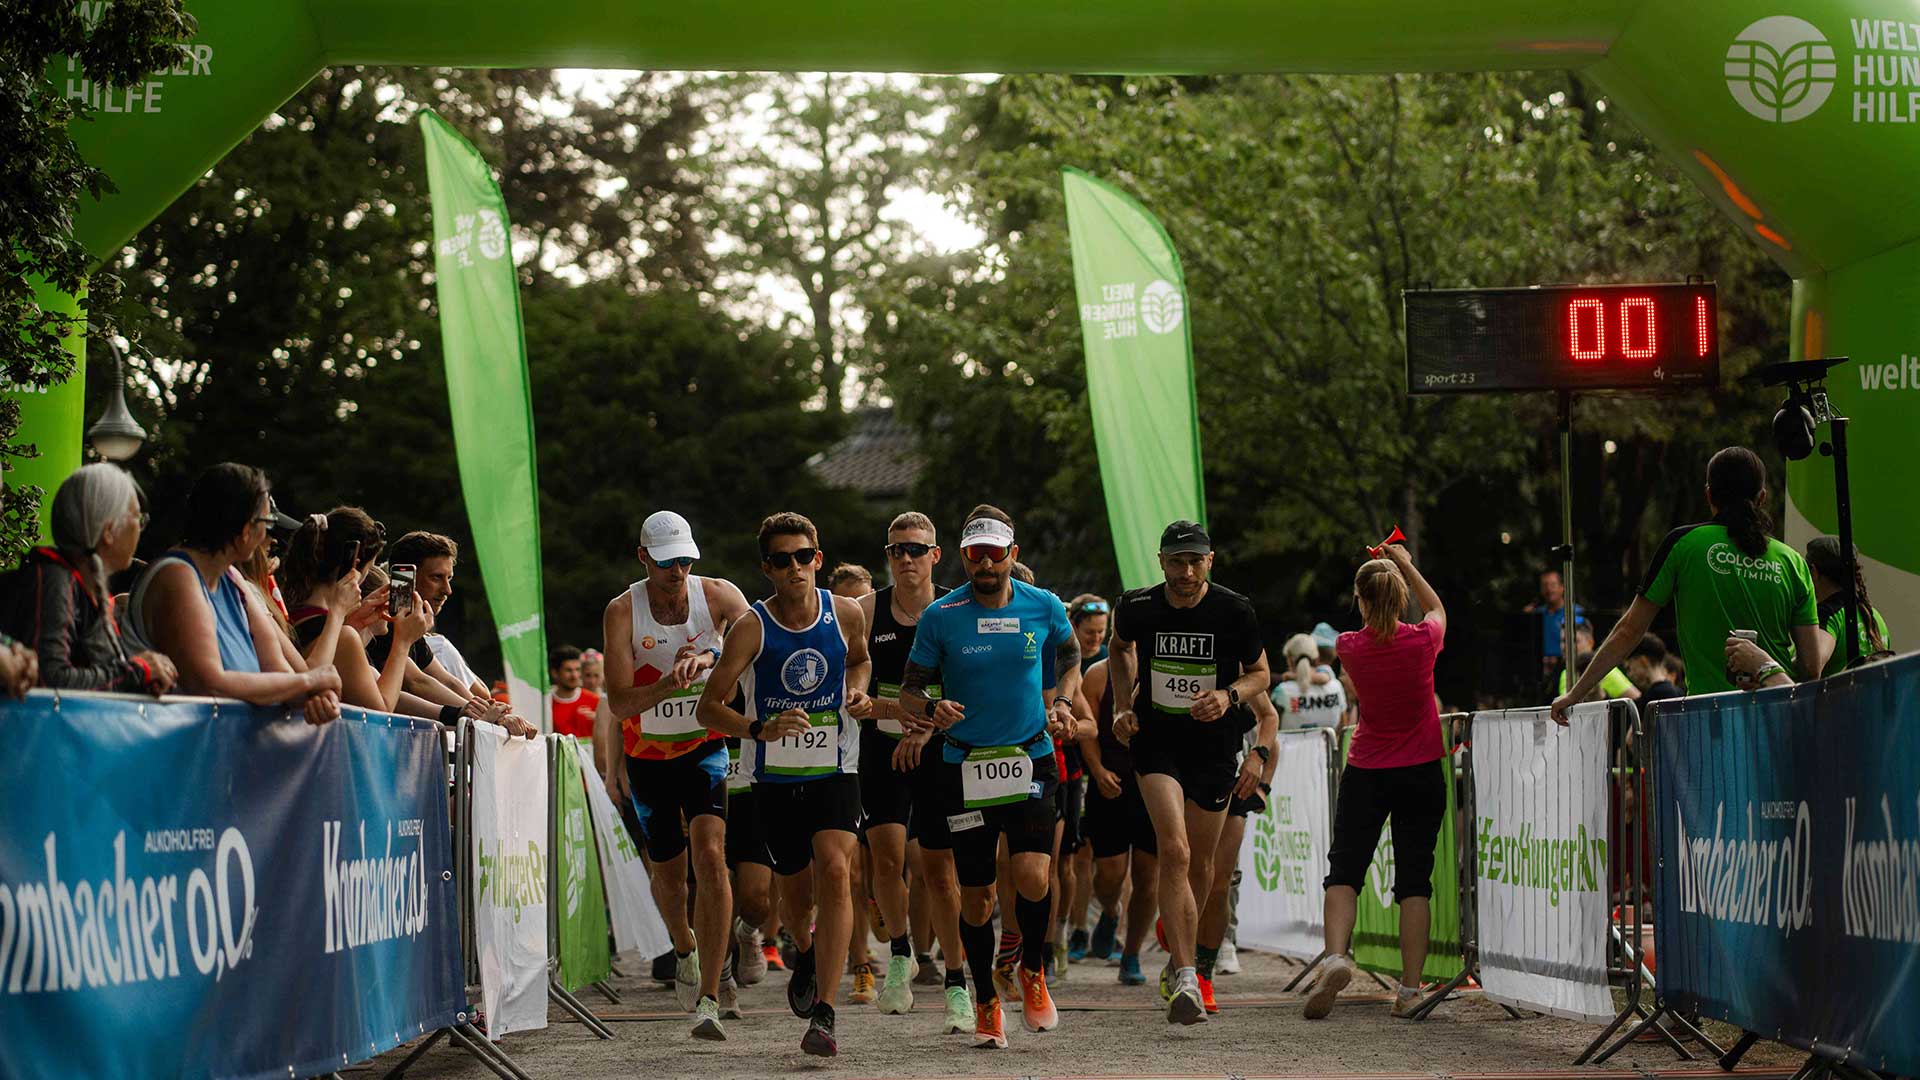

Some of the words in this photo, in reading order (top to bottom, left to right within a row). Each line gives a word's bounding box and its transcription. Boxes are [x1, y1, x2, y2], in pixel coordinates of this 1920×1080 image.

[1424, 371, 1458, 387] sport
[1460, 372, 1476, 384] 23
[1716, 551, 1782, 574] COLOGNE
[1736, 568, 1782, 584] TIMING
[1160, 635, 1210, 656] KRAFT.
[1165, 677, 1201, 694] 486
[655, 699, 698, 718] 1017
[973, 761, 1023, 780] 1006
[144, 828, 216, 853] ALKOHOLFREI
